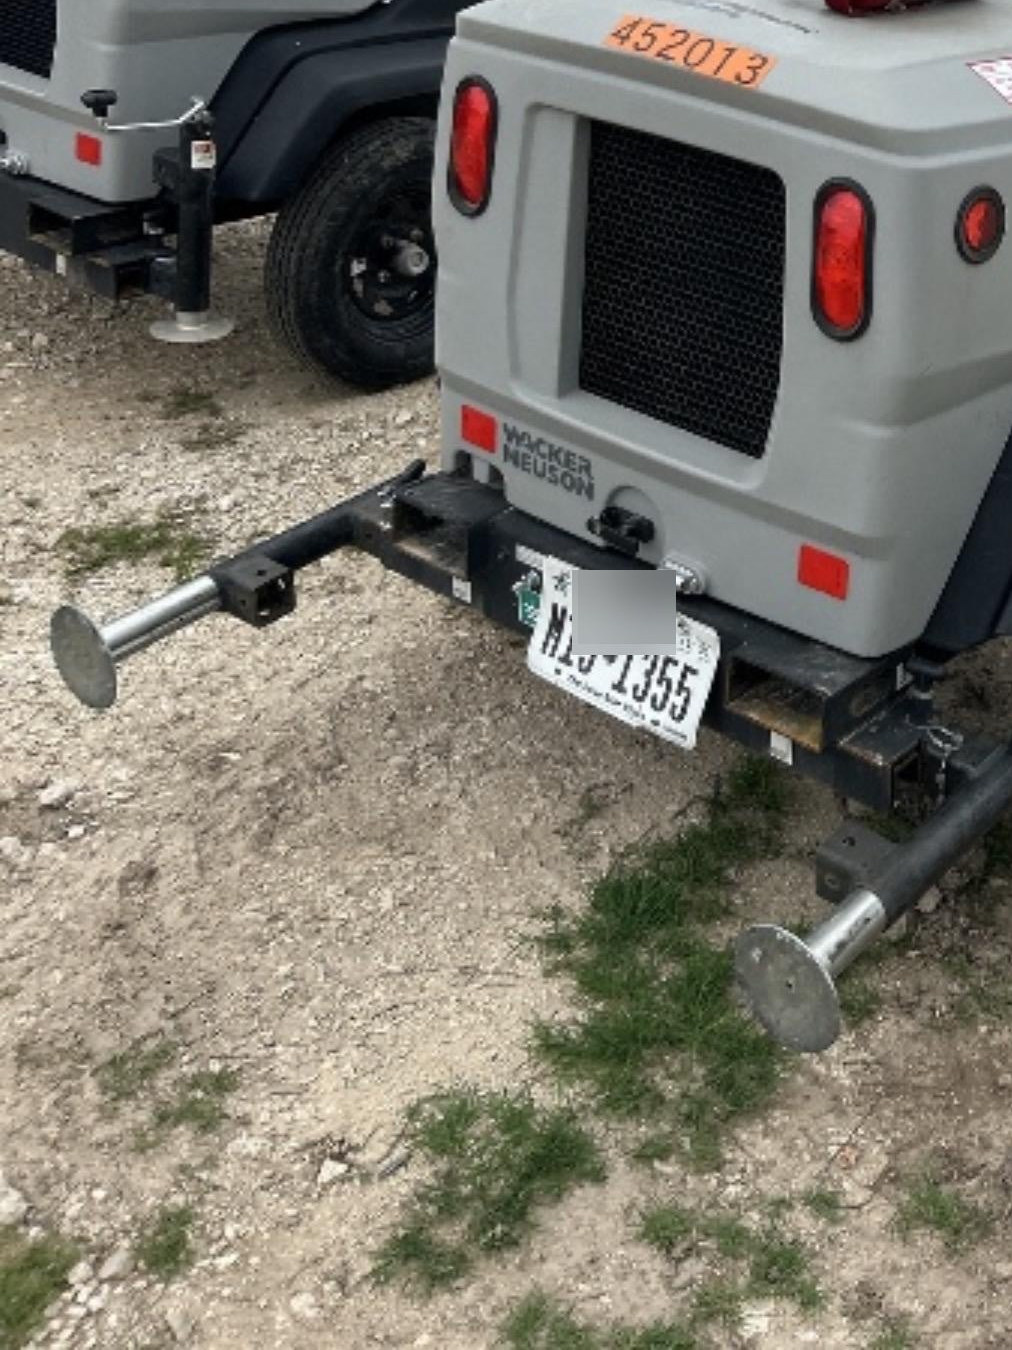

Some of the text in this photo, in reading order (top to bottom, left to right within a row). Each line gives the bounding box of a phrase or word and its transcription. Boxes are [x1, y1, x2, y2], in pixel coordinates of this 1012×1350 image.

[610, 16, 769, 86] 452013
[503, 421, 595, 480] WACKER
[503, 442, 595, 502] NEUSON
